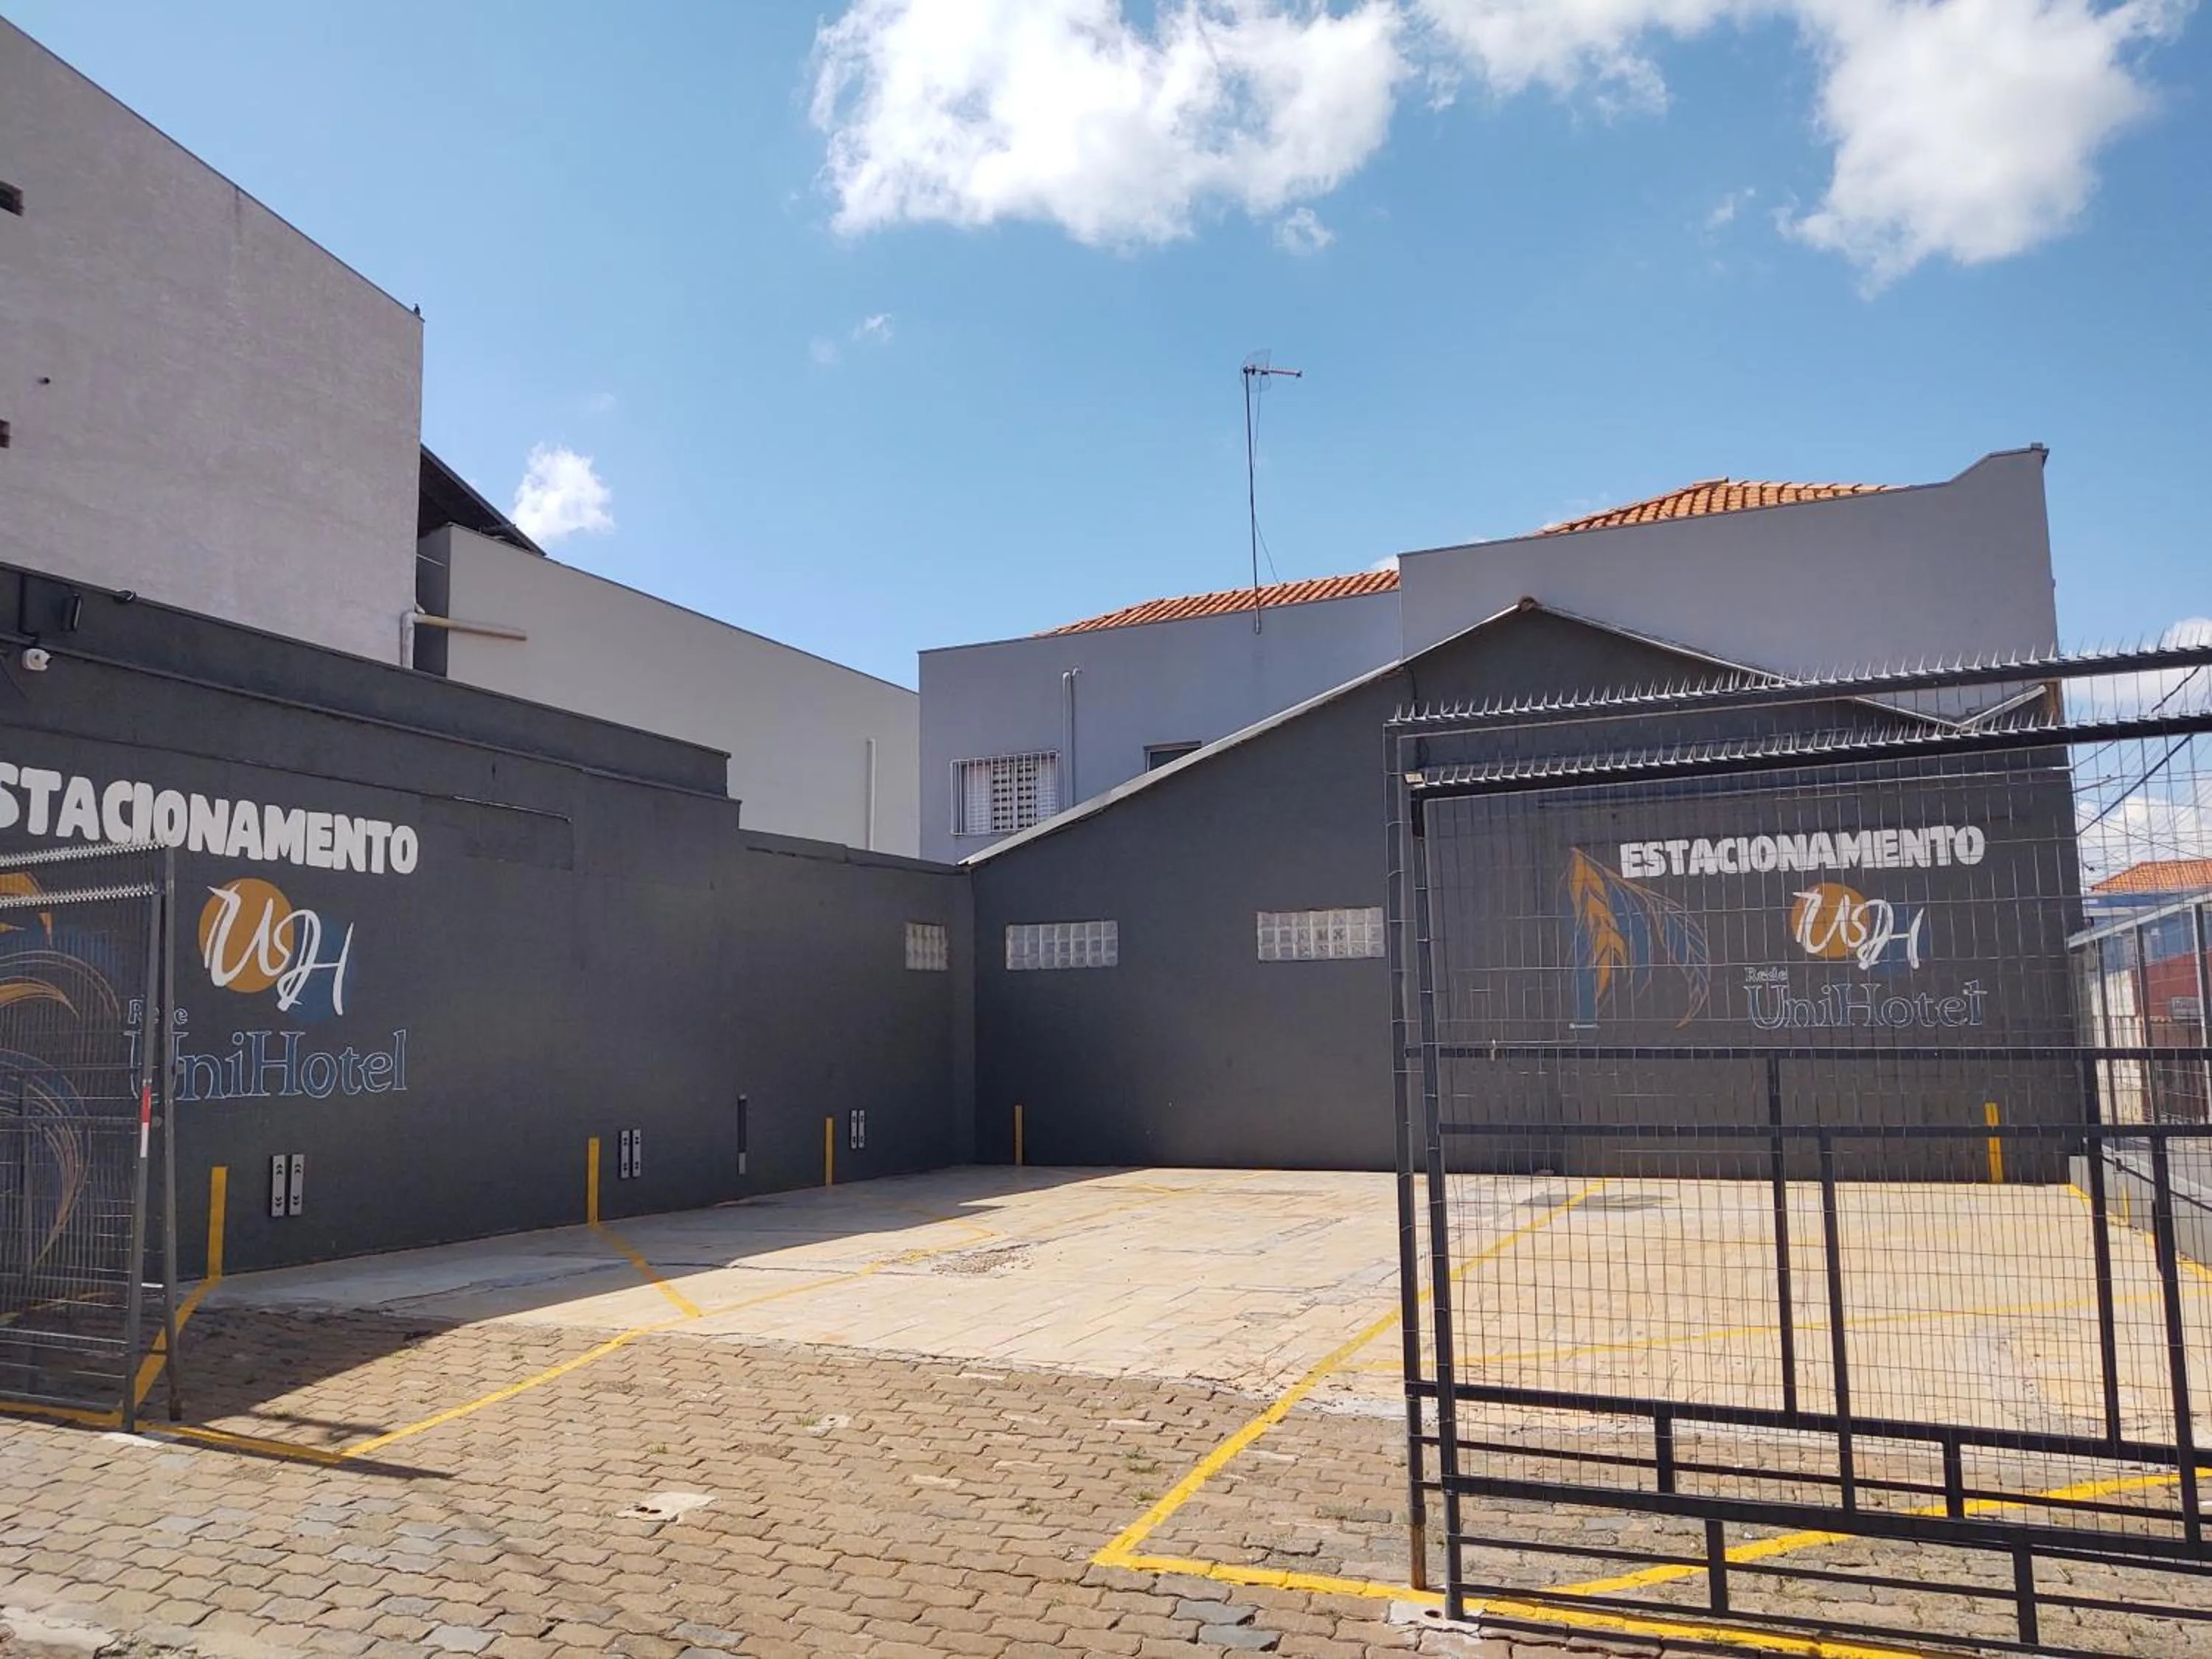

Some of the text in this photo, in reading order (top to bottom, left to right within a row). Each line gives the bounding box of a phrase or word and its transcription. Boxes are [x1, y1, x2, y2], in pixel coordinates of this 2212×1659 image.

[1620, 826, 1986, 877] ESTACIONAMENTO
[1745, 967, 1789, 982] Rede
[1743, 979, 1983, 1029] UniHotel
